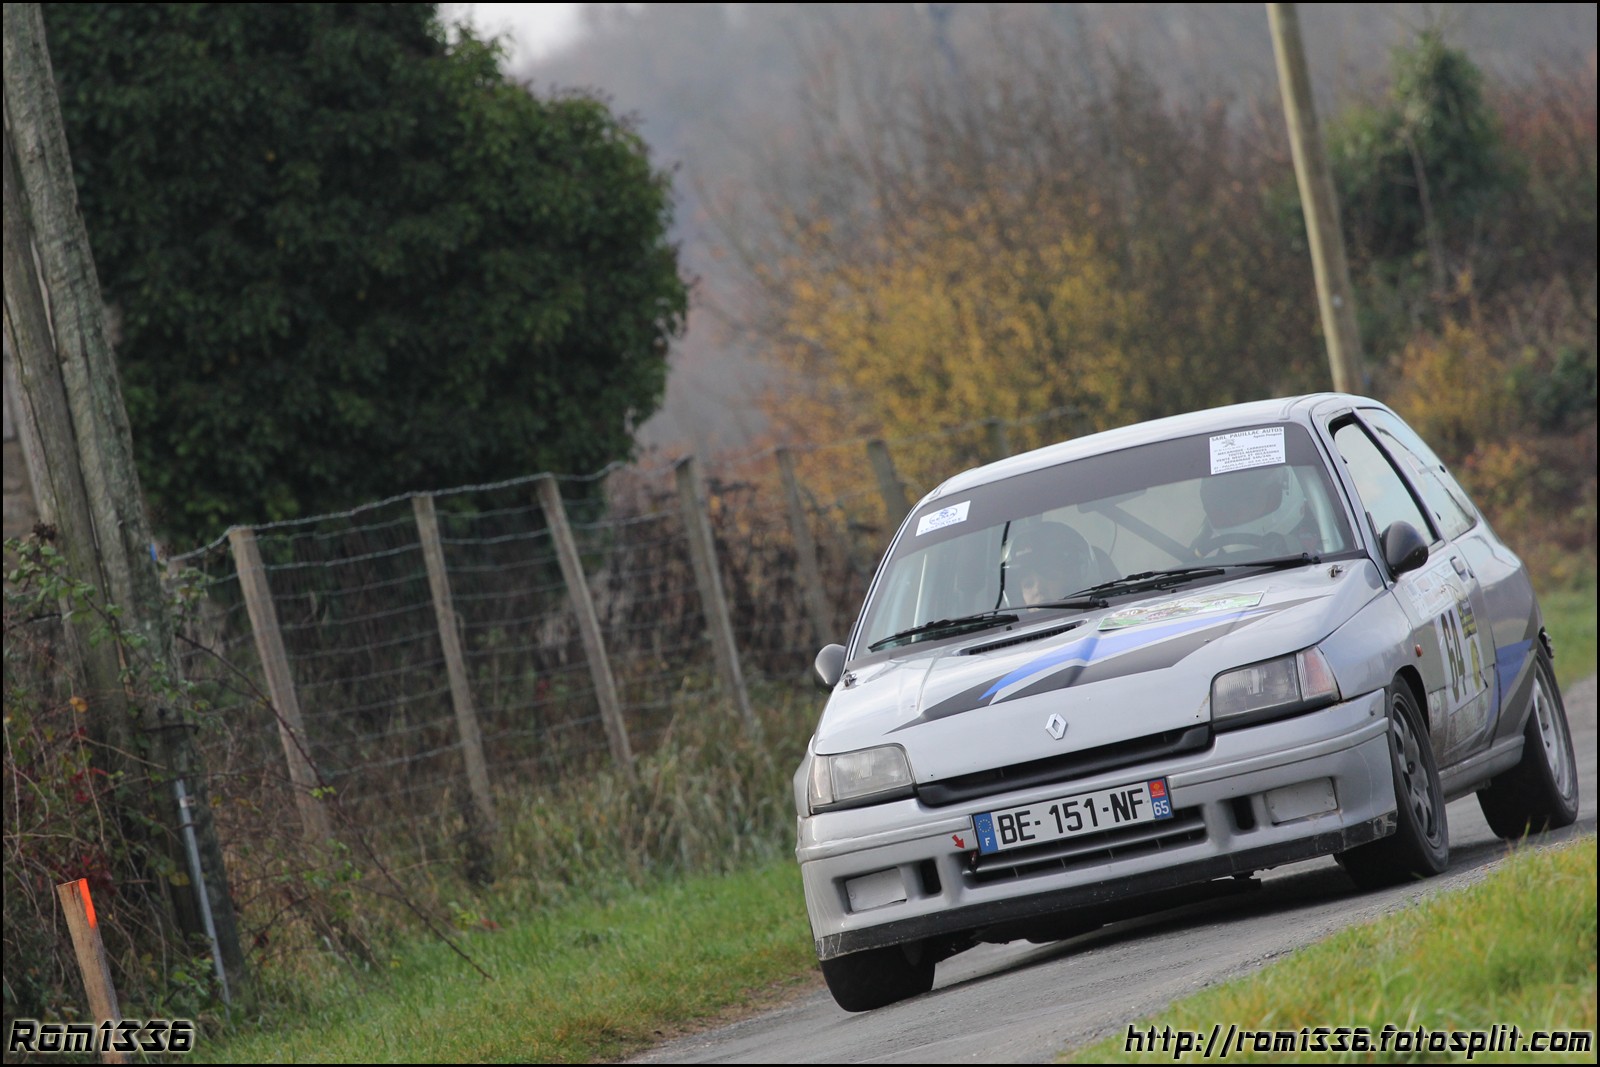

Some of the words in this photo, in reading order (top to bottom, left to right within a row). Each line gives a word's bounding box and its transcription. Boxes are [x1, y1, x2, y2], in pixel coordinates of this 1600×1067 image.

[1230, 430, 1260, 438] PAUILLAC
[1441, 609, 1467, 704] 64
[984, 837, 991, 847] F
[997, 788, 1144, 845] BE-151-NF
[1153, 800, 1170, 816] 65
